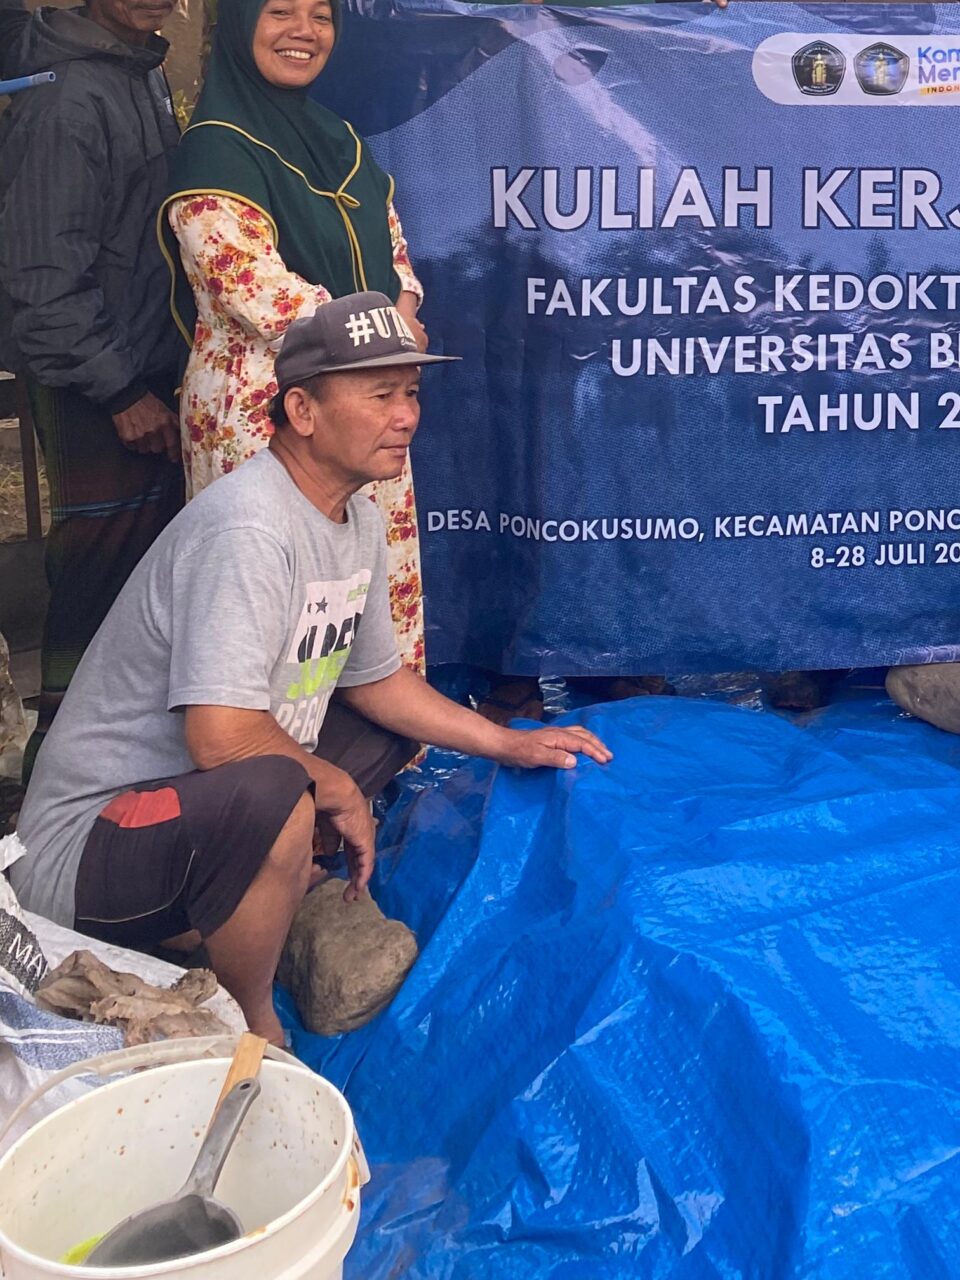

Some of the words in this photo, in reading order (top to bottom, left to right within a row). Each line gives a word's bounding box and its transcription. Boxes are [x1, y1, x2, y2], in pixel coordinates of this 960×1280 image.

[493, 168, 770, 229] KULIAH
[528, 276, 756, 316] FAKULTAS
[612, 333, 912, 376] UNIVERSITAS
[758, 393, 918, 432] TAHUN
[428, 510, 491, 531] DESA
[501, 514, 704, 542] PONCOKUSUMO,
[716, 512, 879, 537] KECAMATAN
[811, 546, 864, 567] 8-28
[875, 544, 924, 565] JULI
